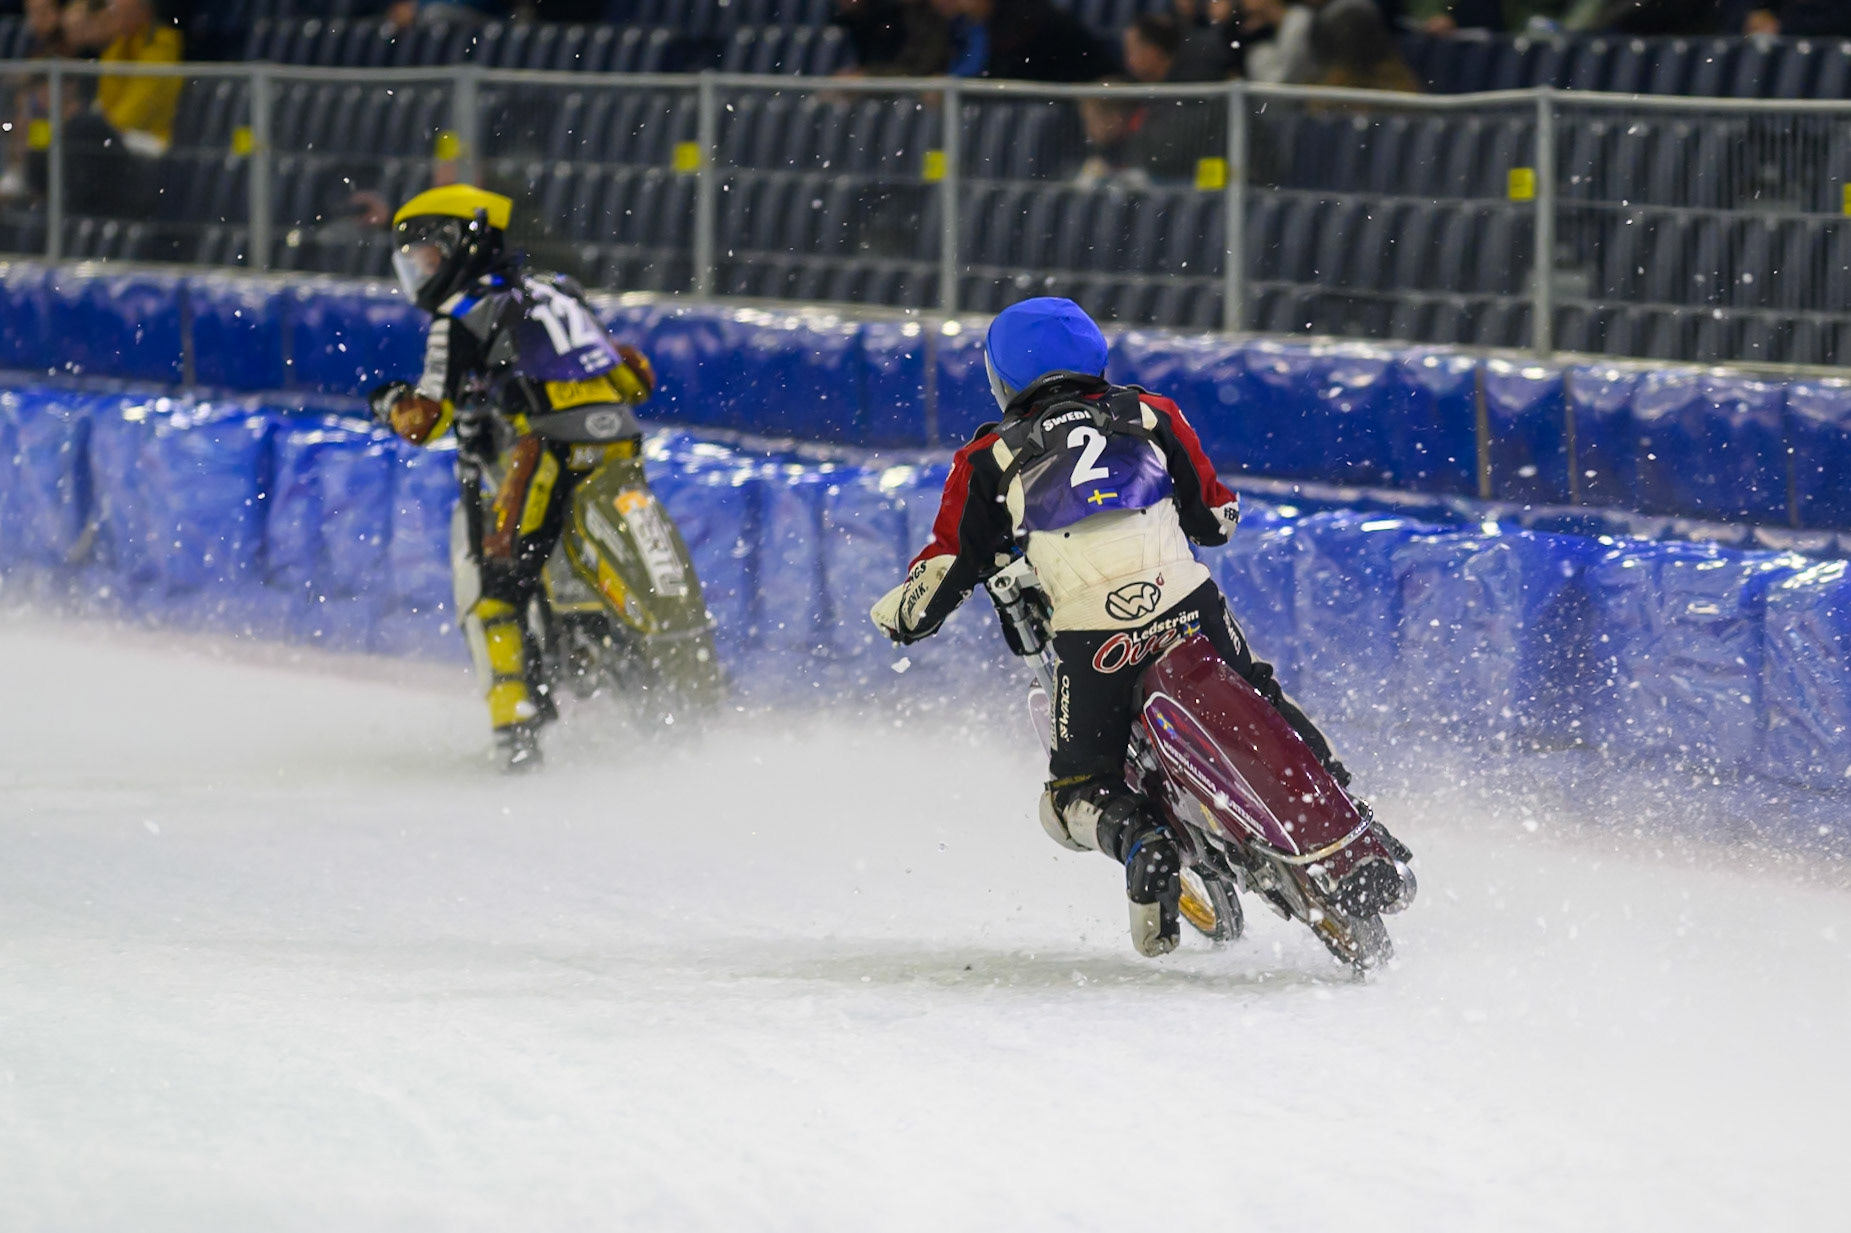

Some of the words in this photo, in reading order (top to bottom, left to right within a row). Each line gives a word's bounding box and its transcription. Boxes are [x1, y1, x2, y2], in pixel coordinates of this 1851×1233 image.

[530, 293, 601, 356] 12
[1066, 426, 1109, 488] 2
[1092, 628, 1177, 674] Ove
[1133, 609, 1200, 643] Ledström
